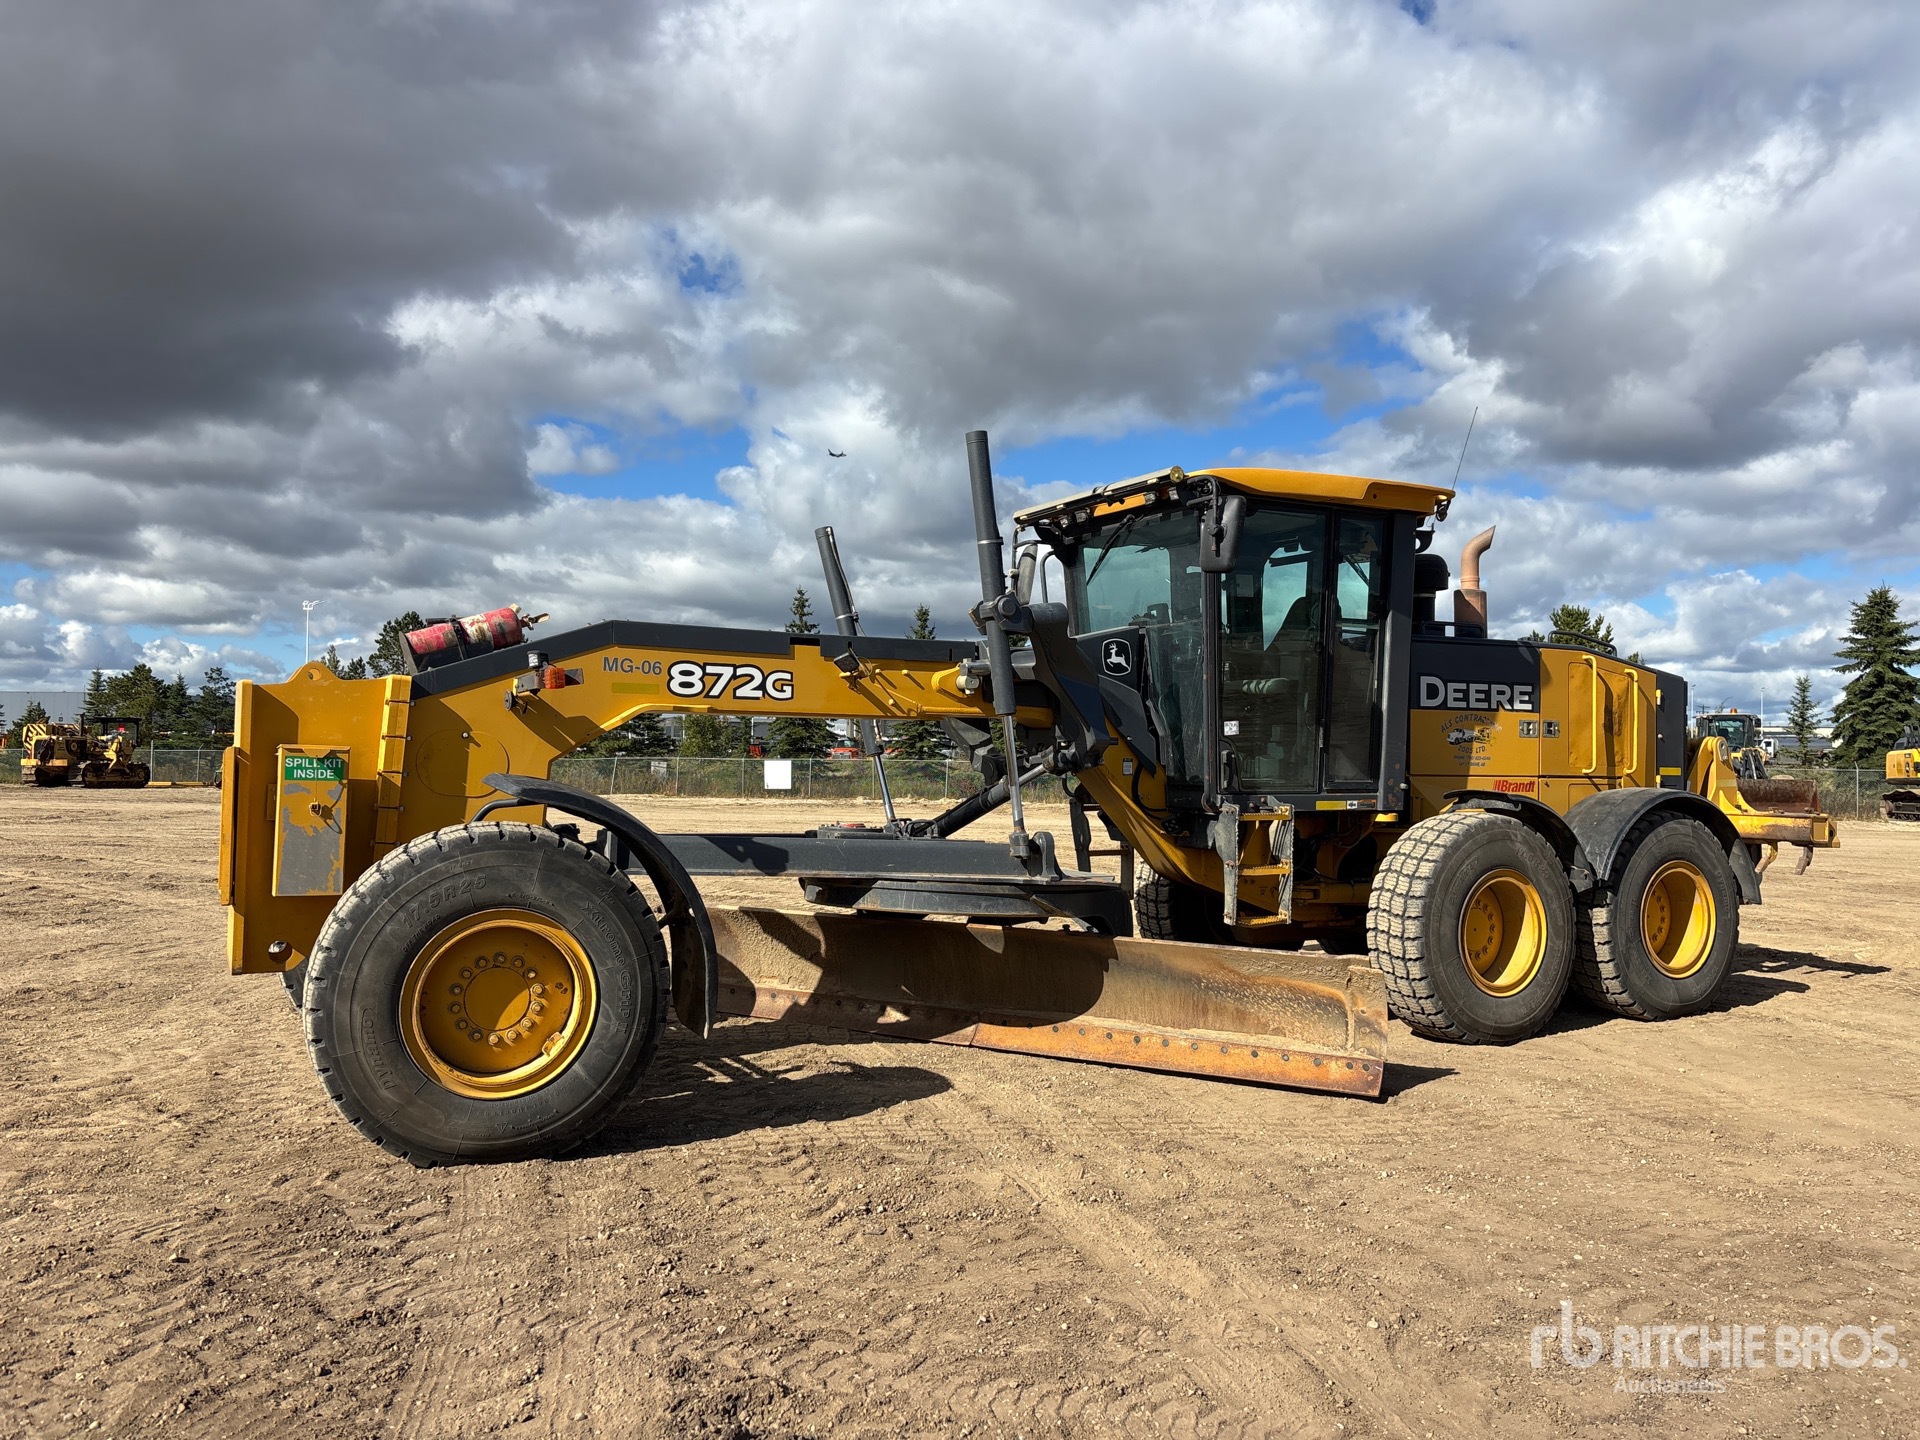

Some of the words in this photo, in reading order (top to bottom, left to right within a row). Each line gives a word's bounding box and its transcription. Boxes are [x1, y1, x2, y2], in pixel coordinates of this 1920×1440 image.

[603, 656, 662, 675] MG-06
[667, 660, 794, 700] 872G
[1420, 676, 1532, 710] DEERE
[1454, 713, 1503, 733] CONTRAC
[285, 757, 321, 768] SPILL
[324, 759, 343, 768] KIT
[293, 769, 335, 779] INSIDE
[1499, 780, 1536, 792] Brandt
[400, 874, 487, 929] 17.5R25
[616, 969, 633, 1018] Grip
